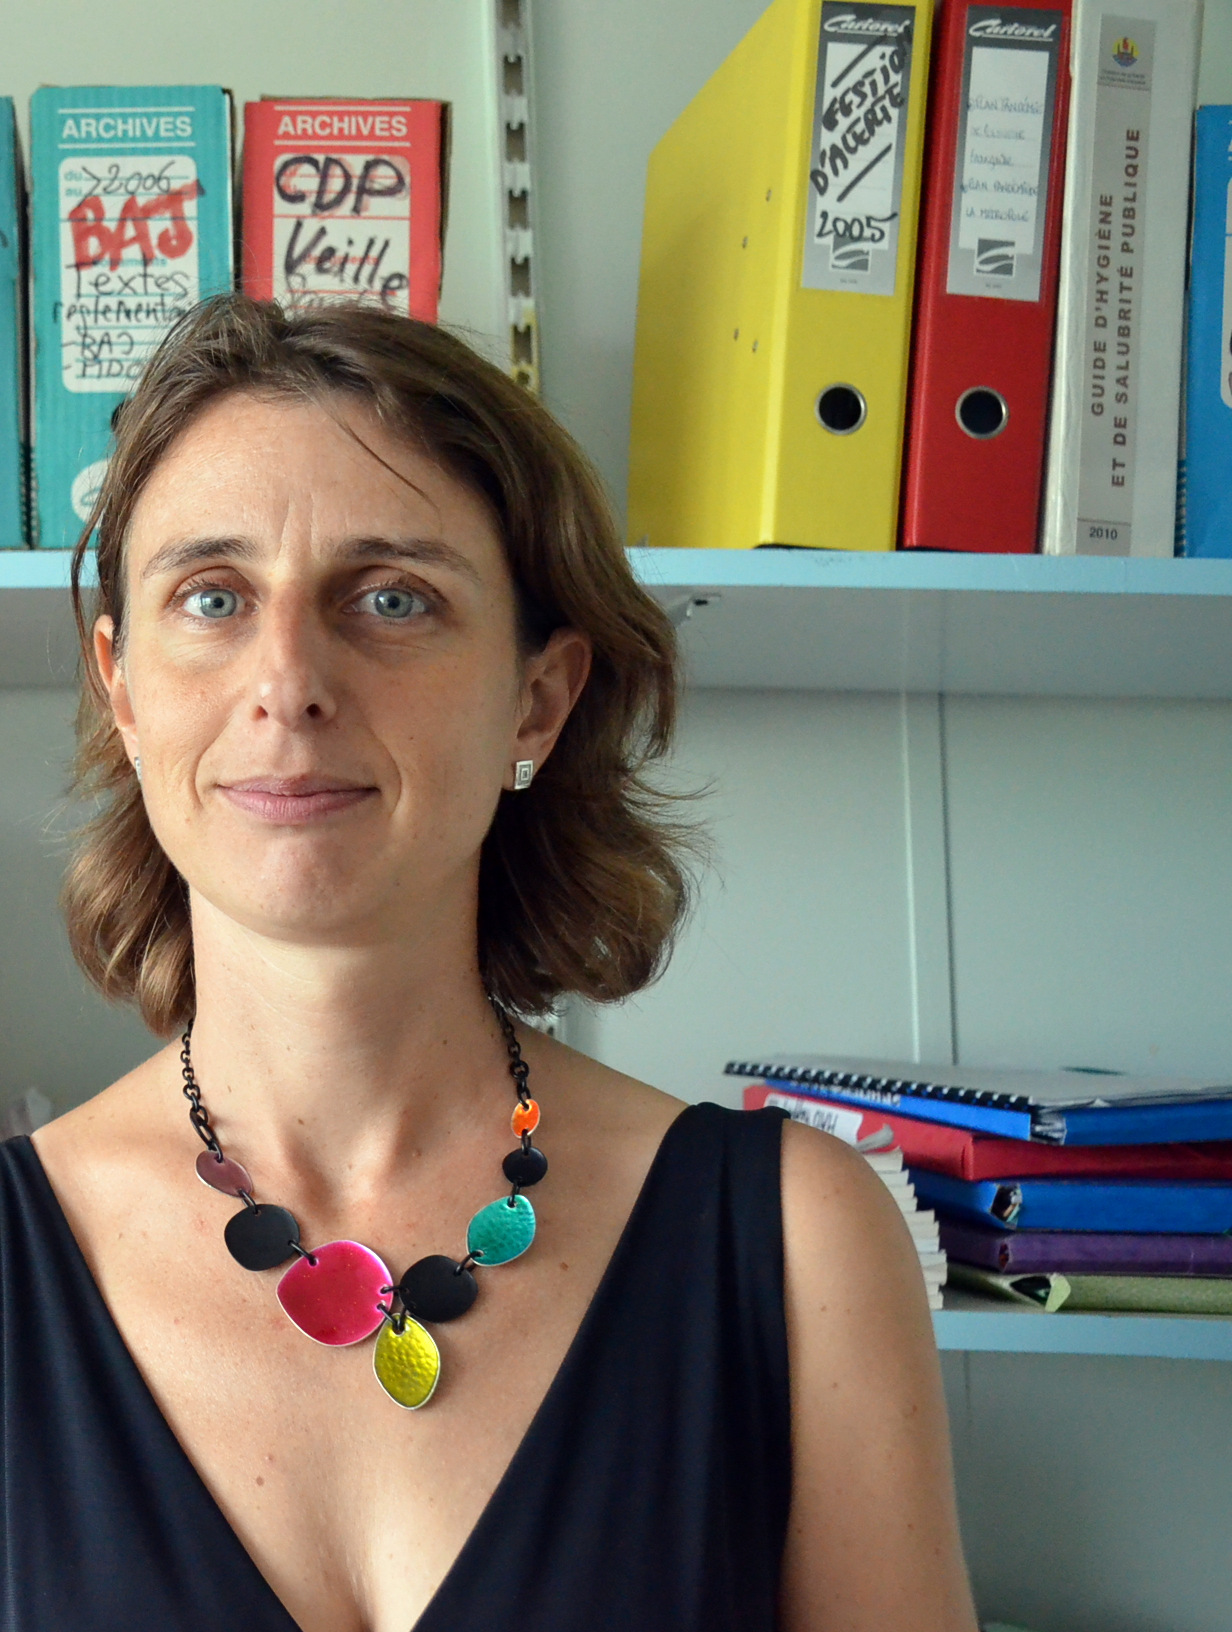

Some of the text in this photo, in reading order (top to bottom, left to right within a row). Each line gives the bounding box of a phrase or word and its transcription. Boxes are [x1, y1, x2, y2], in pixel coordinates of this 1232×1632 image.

[824, 14, 910, 34] Cartorel
[969, 18, 1056, 39] Cartorel
[62, 116, 193, 140] ARCHIVES
[277, 115, 408, 137] ARCHIVES
[275, 154, 406, 216] CDP
[816, 211, 899, 243] 2005
[65, 252, 190, 300] Textes
[283, 217, 410, 310] Veille
[1091, 193, 1113, 416] GUIDE D'HYGIÈNE
[1111, 129, 1141, 487] ET DE SALUBRITÉ PUBLIQUE
[1089, 527, 1118, 541] 2010
